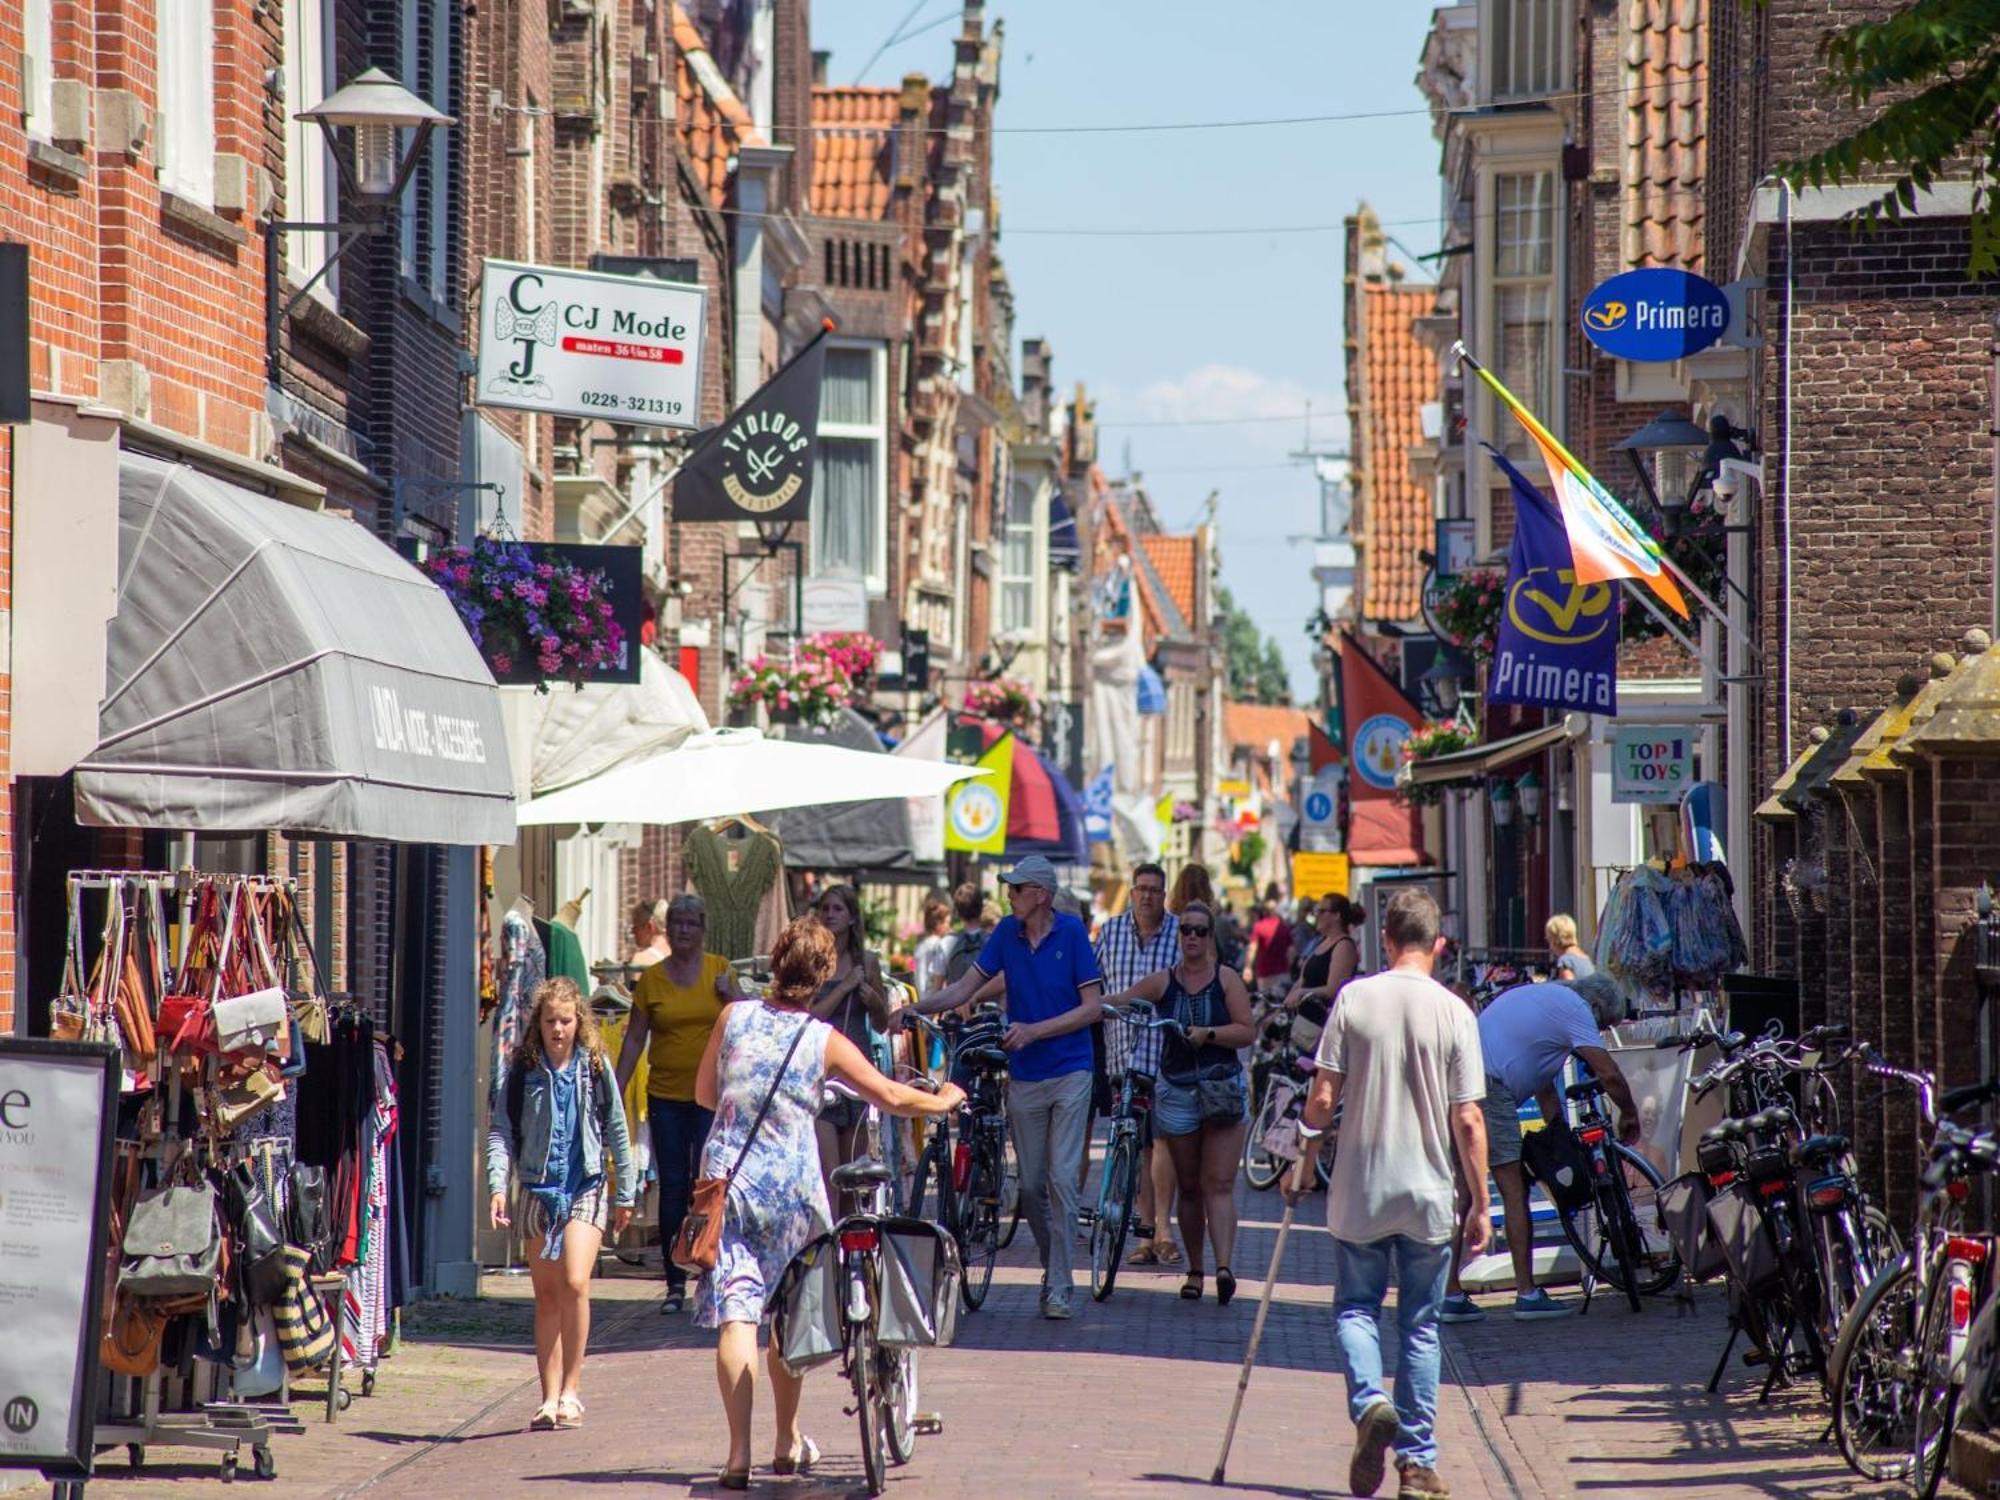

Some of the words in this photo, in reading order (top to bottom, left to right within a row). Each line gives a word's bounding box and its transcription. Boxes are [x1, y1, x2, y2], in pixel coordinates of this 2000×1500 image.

[509, 274, 543, 315] C
[564, 304, 600, 330] CJ
[613, 310, 686, 341] Mode
[1636, 300, 1723, 330] Primera
[509, 337, 537, 379] J
[575, 341, 611, 355] maten
[648, 348, 664, 360] 58
[581, 391, 682, 416] 0228-321319
[1495, 651, 1611, 706] Primera
[1626, 743, 1668, 760] TOP
[1671, 739, 1683, 760] 1
[1630, 764, 1681, 780] TOYS
[9, 1403, 33, 1427] IN
